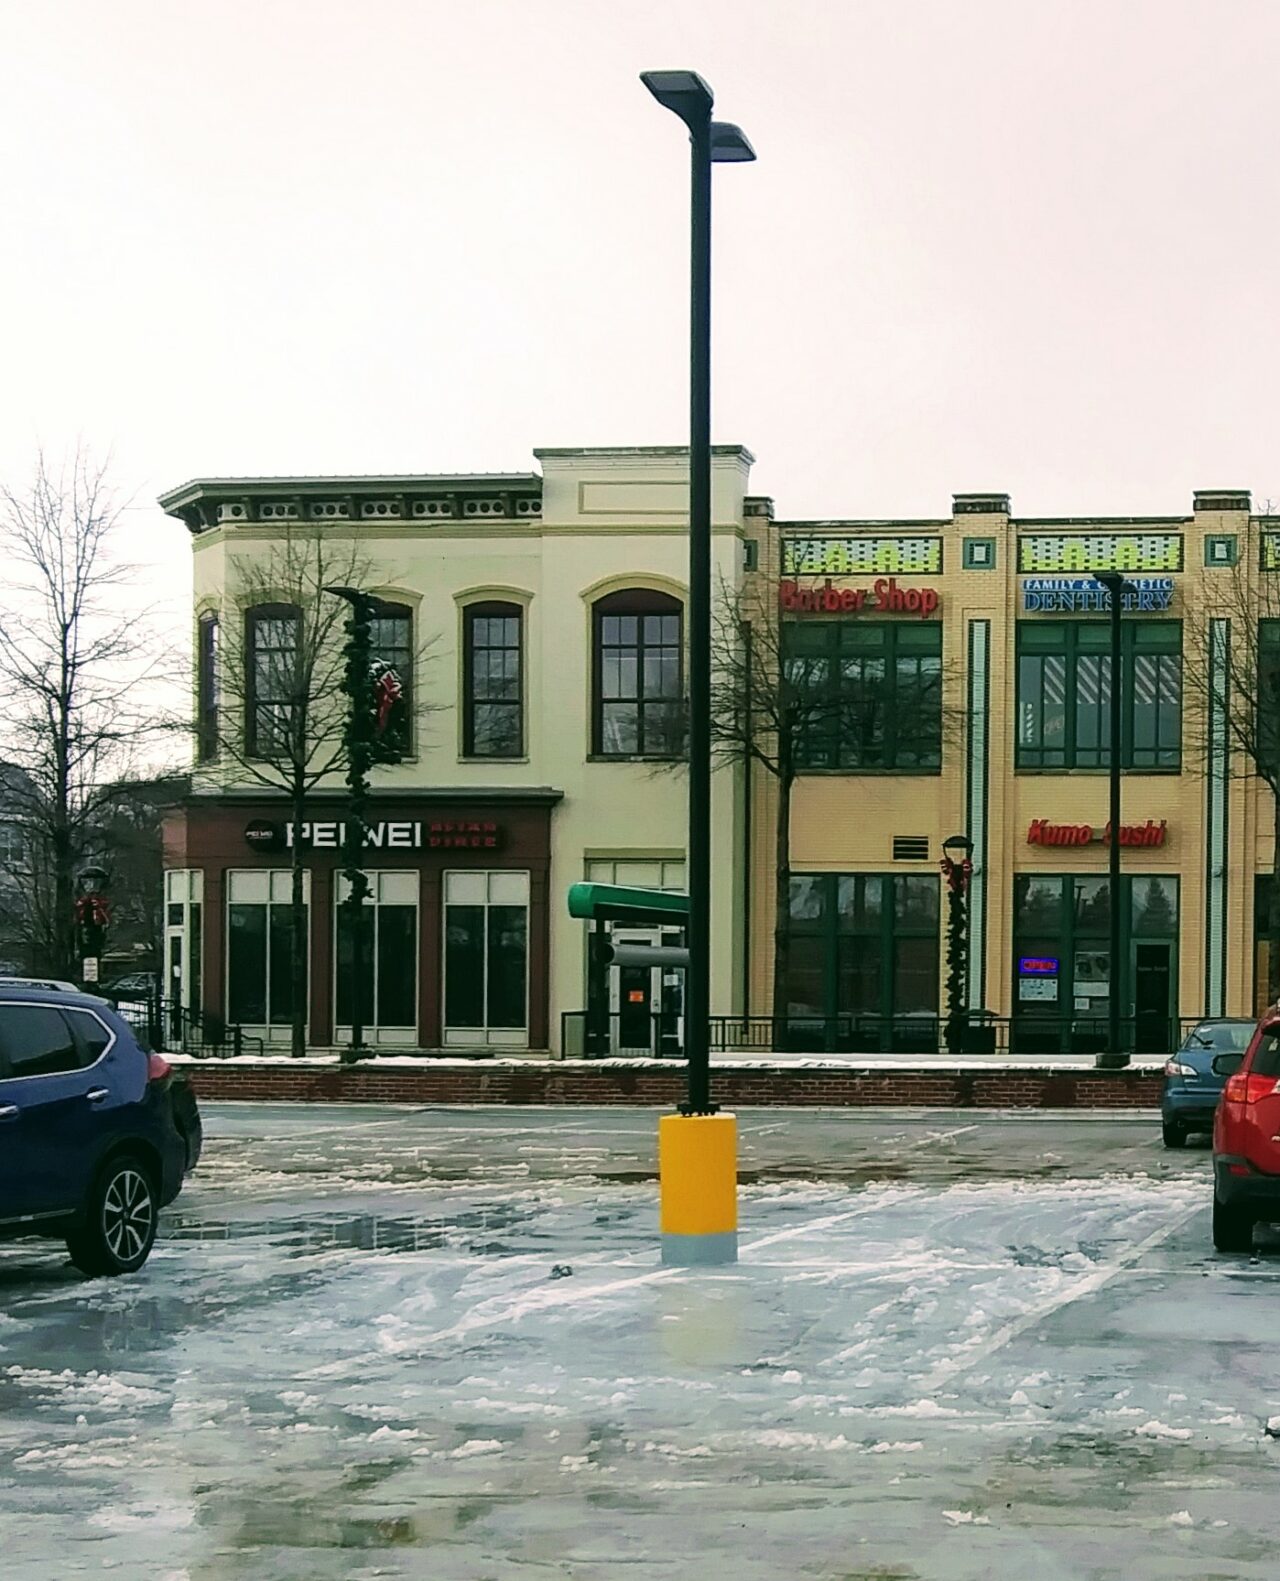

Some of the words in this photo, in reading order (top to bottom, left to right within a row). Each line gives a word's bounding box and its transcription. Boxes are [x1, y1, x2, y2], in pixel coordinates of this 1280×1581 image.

[1026, 579, 1075, 589] FAMILY
[1081, 579, 1090, 589] &
[779, 578, 867, 612] Barber
[874, 577, 938, 619] Shop
[286, 822, 346, 847] PEI
[360, 822, 422, 847] WEI
[1027, 819, 1093, 846] Kumo
